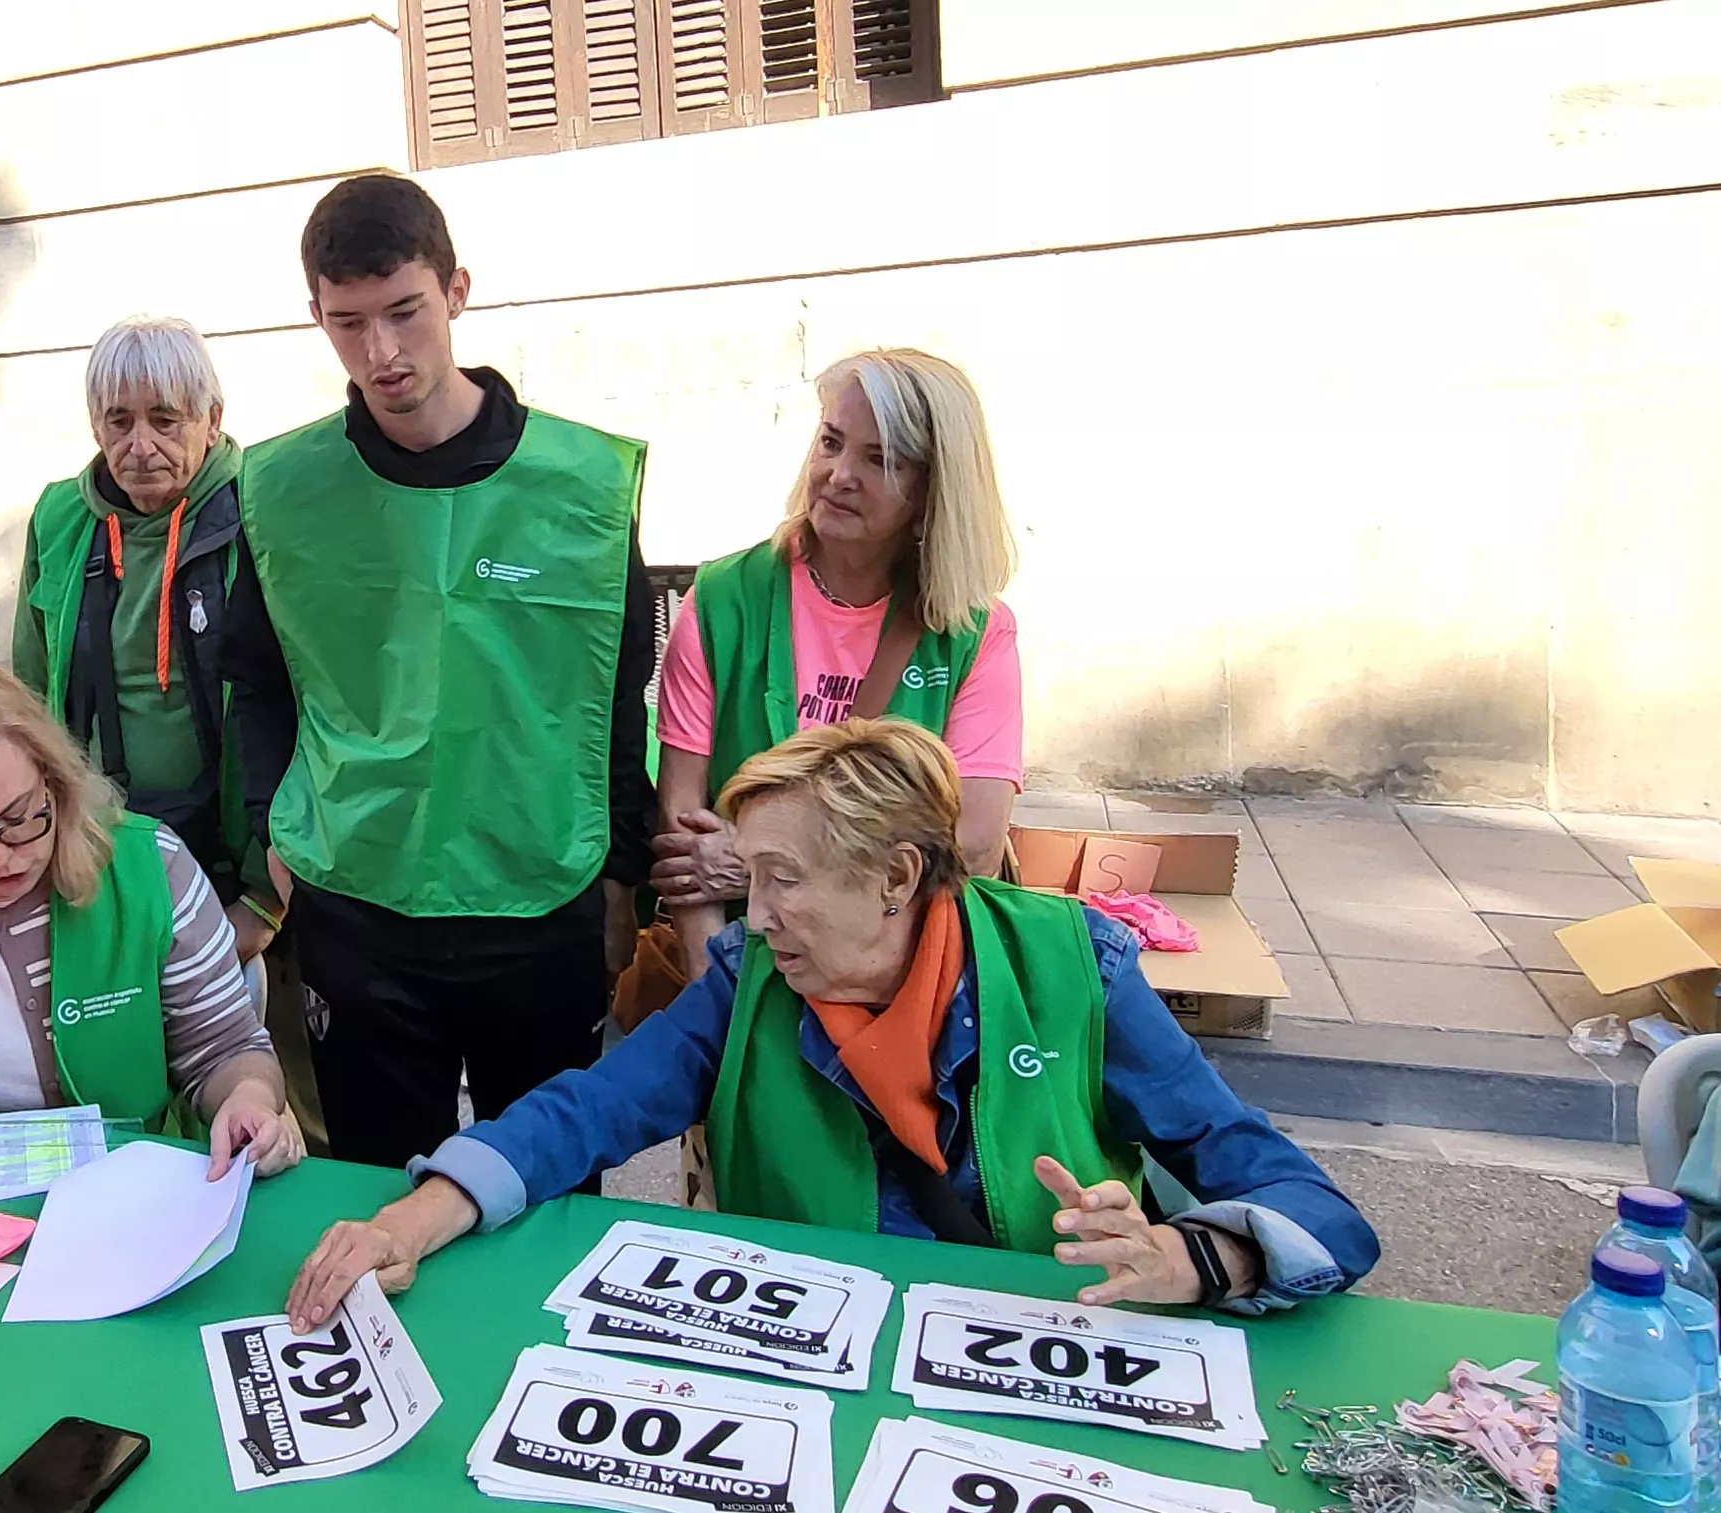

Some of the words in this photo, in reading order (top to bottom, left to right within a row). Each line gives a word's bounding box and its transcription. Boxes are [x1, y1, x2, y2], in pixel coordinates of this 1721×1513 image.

[1086, 854, 1126, 894] S
[600, 1283, 684, 1311] CÁNCER
[641, 1255, 808, 1320] 501
[666, 1310, 729, 1332] HUESCA
[690, 1305, 715, 1319] EL
[718, 1312, 812, 1341] CONTRA
[243, 1332, 273, 1383] CÁNCER
[680, 1337, 748, 1356] HUESCA
[811, 1345, 823, 1353] XI
[964, 1323, 1160, 1387] 402
[280, 1320, 373, 1429] 462
[930, 1362, 1034, 1389] CÁNCER
[237, 1375, 261, 1416] HUESCA
[262, 1382, 279, 1399] EL
[1018, 1389, 1099, 1410] HUESCA
[1041, 1381, 1070, 1397] EL
[1078, 1387, 1196, 1416] CONTRA
[264, 1398, 296, 1461] CONTRA
[557, 1398, 744, 1471] 700
[516, 1439, 617, 1471] CÁNCER
[598, 1471, 675, 1494] HUESCA
[624, 1462, 652, 1479] EL
[659, 1467, 771, 1498] CONTRA
[774, 1503, 787, 1512] XI
